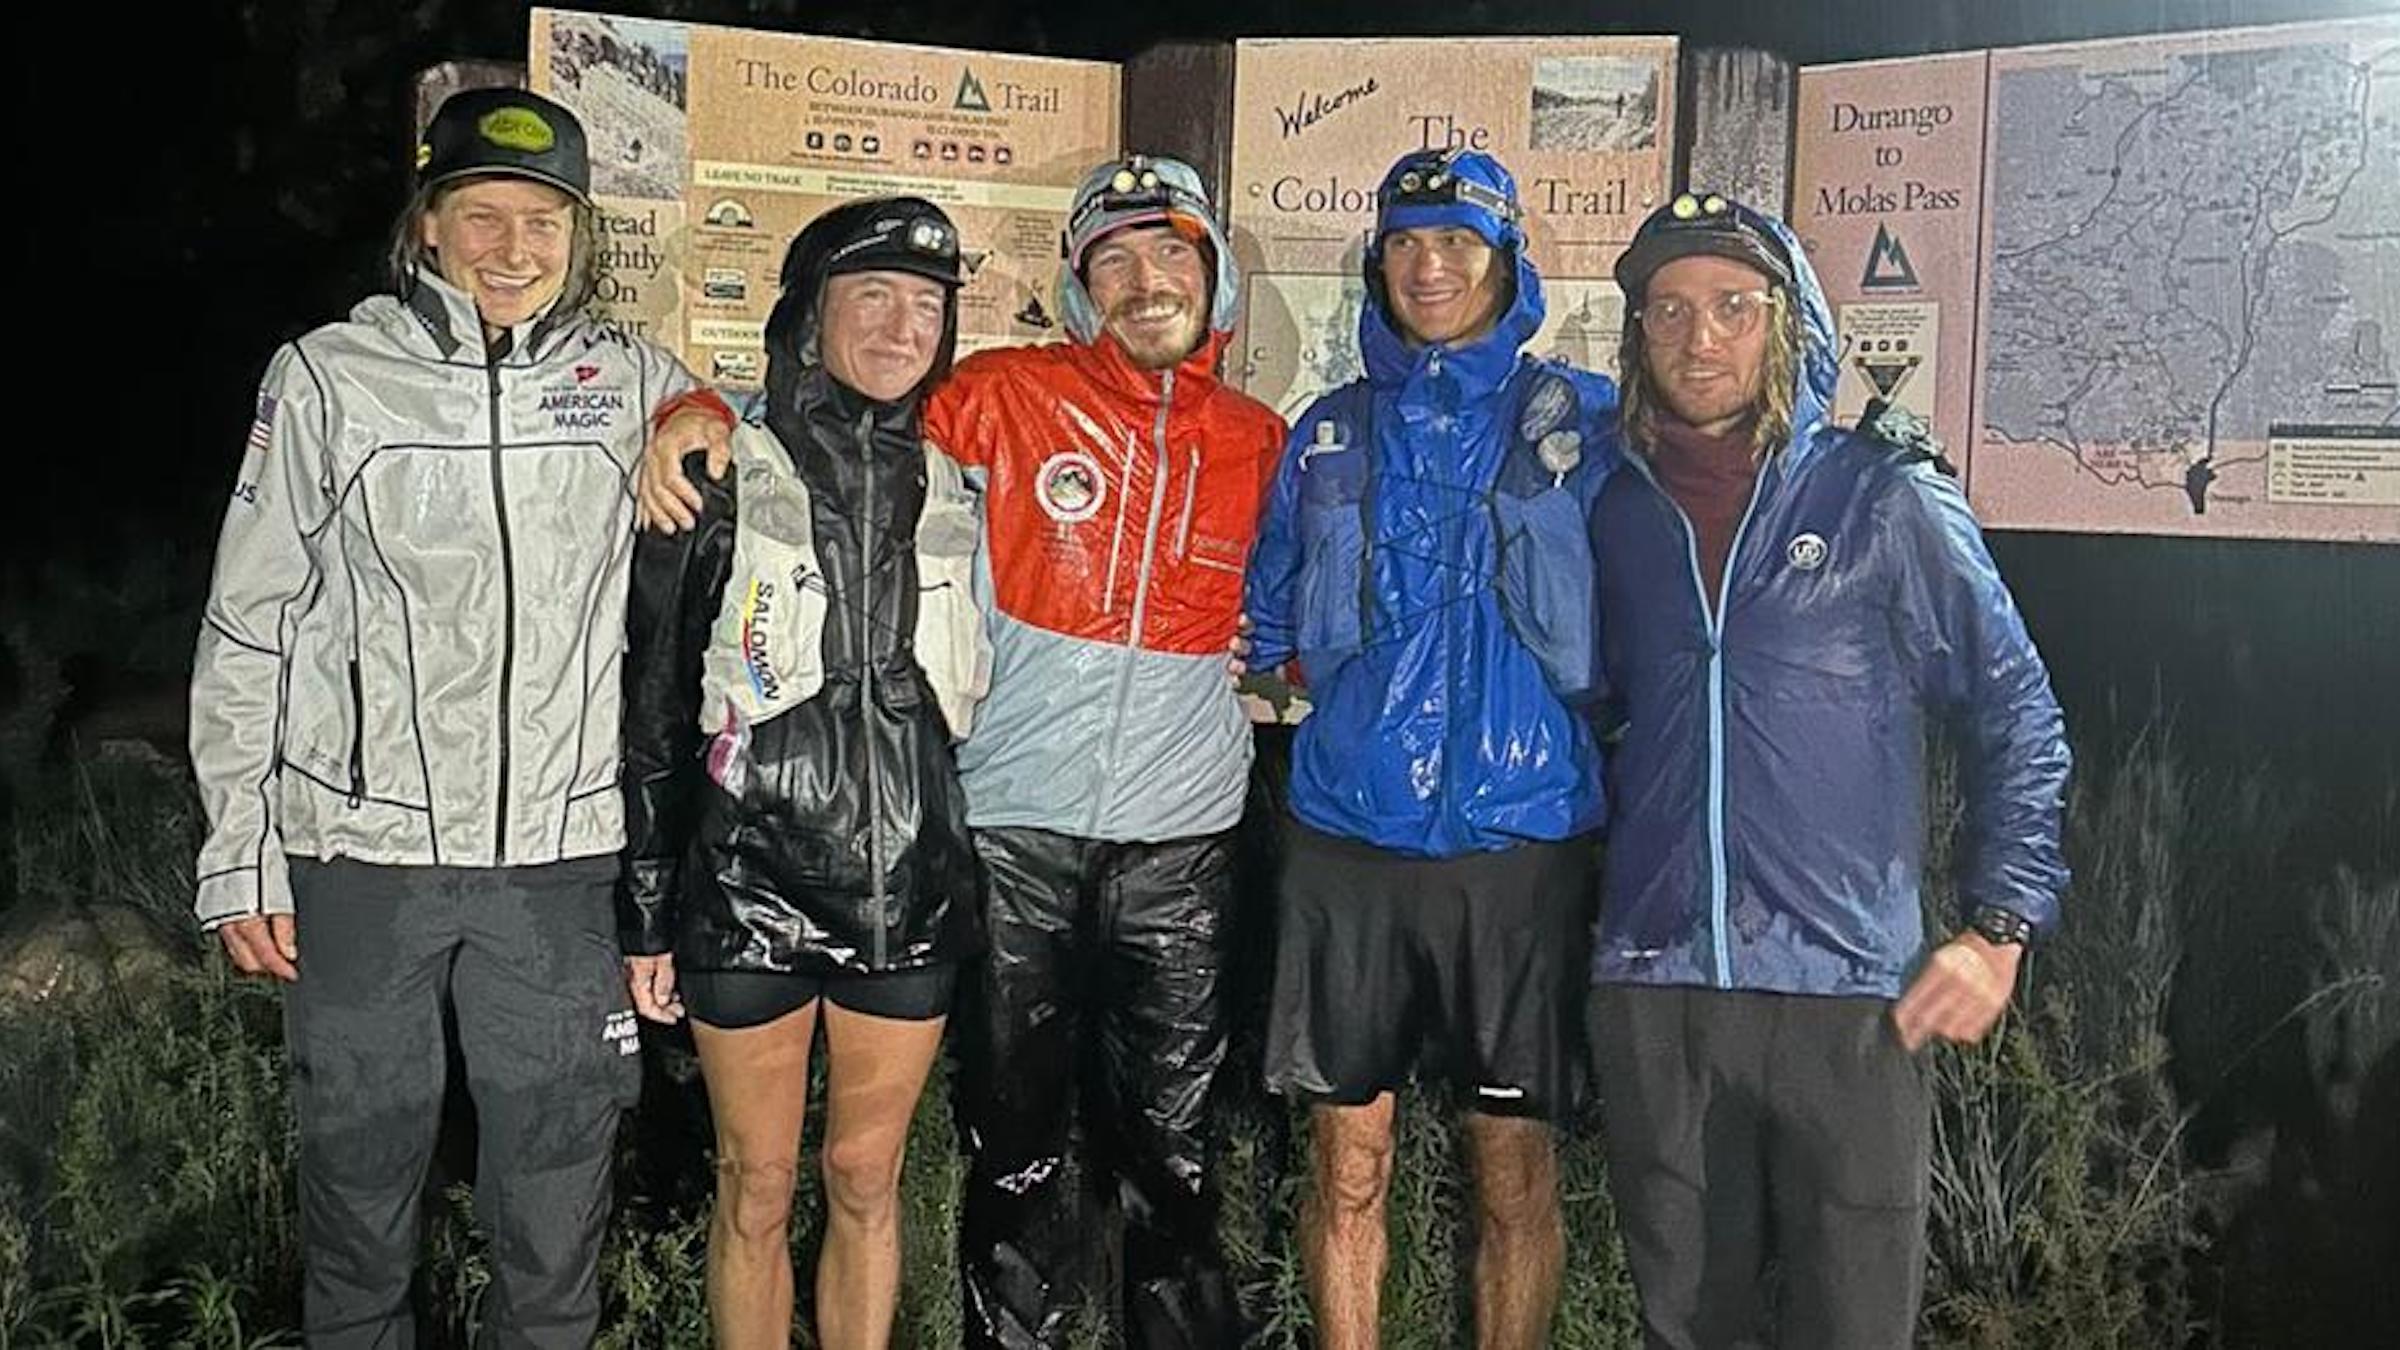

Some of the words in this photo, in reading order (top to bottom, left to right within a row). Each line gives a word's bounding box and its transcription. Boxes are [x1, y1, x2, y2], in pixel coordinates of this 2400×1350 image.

[736, 59, 798, 92] The
[807, 65, 938, 103] Colorado
[996, 81, 1061, 114] Trail
[1275, 77, 1380, 140] Welcome
[1831, 102, 1953, 137] Durango
[1407, 114, 1489, 151] The
[1875, 146, 1903, 167] to
[1272, 175, 1380, 213] Color
[1533, 177, 1628, 215] Trail
[1814, 183, 1897, 216] Molas
[1903, 181, 1962, 211] Pass
[598, 209, 657, 238] read
[597, 241, 665, 279] ghtly
[594, 273, 638, 303] On
[538, 394, 624, 411] AMERICAN
[553, 412, 612, 429] MAGIC
[748, 581, 782, 701] SALOMON
